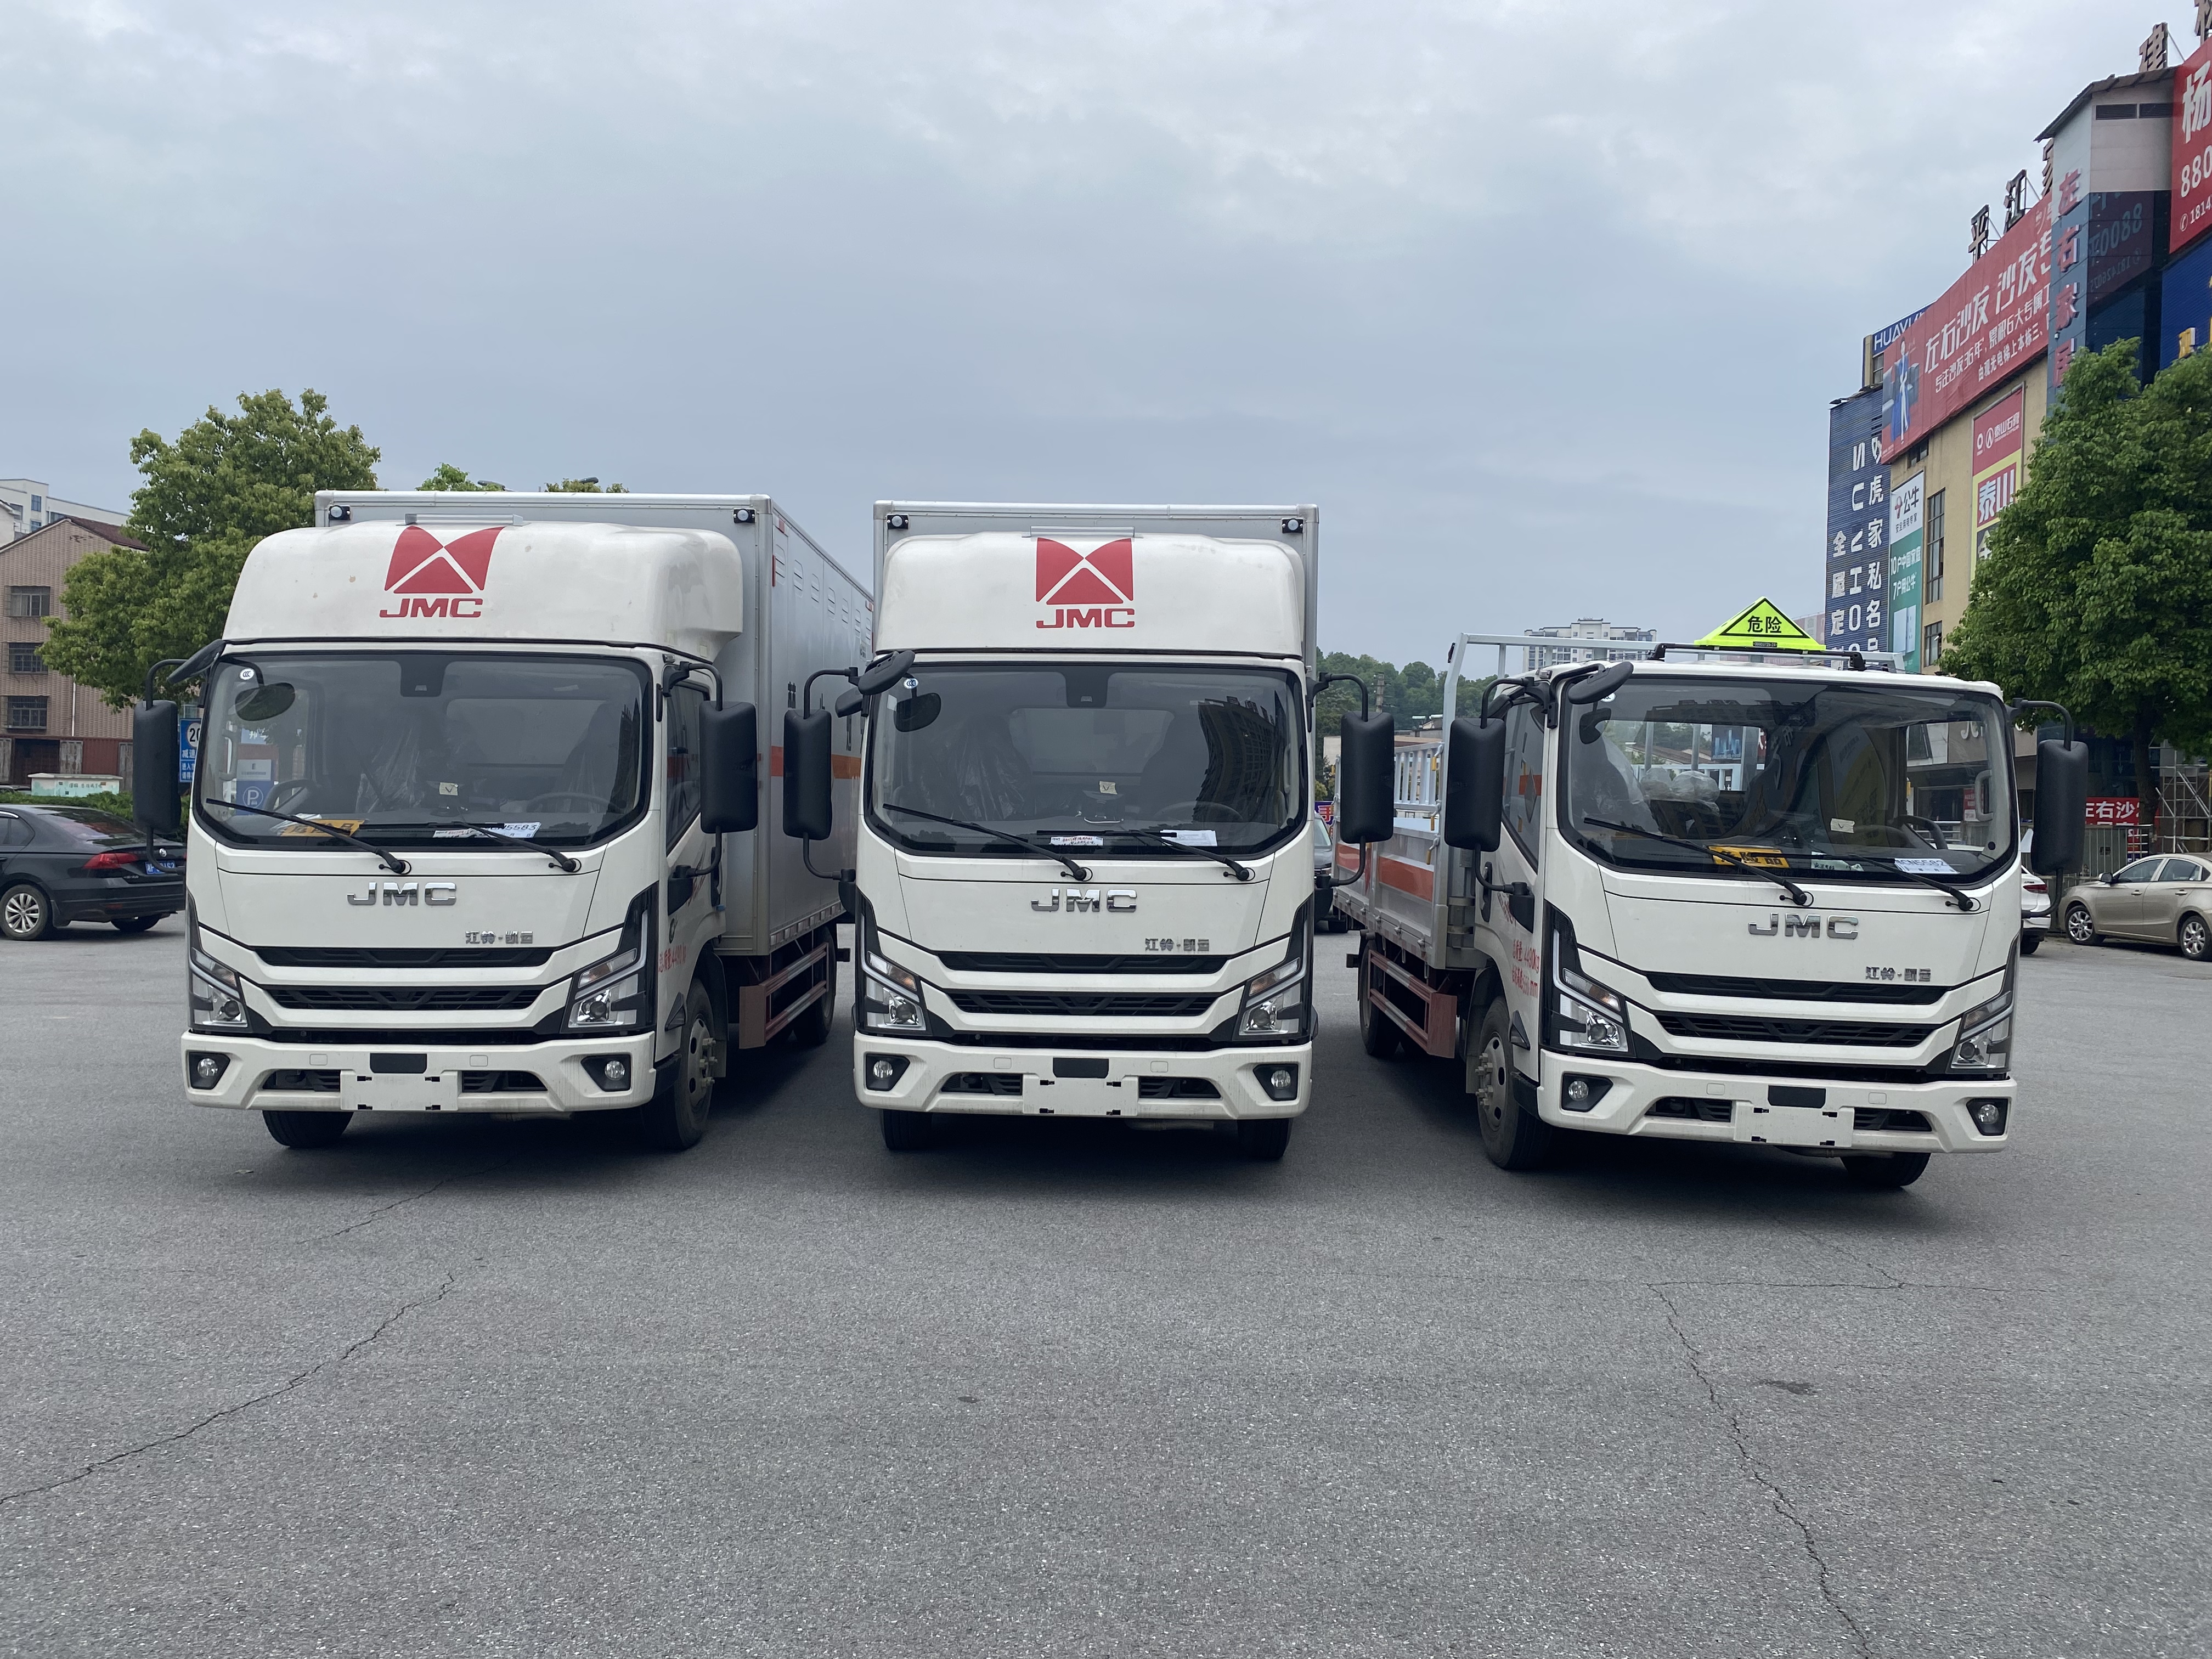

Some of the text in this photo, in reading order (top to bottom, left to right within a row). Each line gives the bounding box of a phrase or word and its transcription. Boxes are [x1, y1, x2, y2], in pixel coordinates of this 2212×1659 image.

[1925, 285, 1990, 374] 左右沙发
[1978, 469, 2015, 524] 泰山
[379, 598, 483, 618] JMC
[1036, 608, 1135, 629] JMC
[1747, 615, 1782, 634] 危险
[2085, 800, 2140, 819] 右沙
[347, 882, 458, 906] JMC
[1031, 889, 1137, 912] JMC
[1748, 913, 1858, 939] JMC
